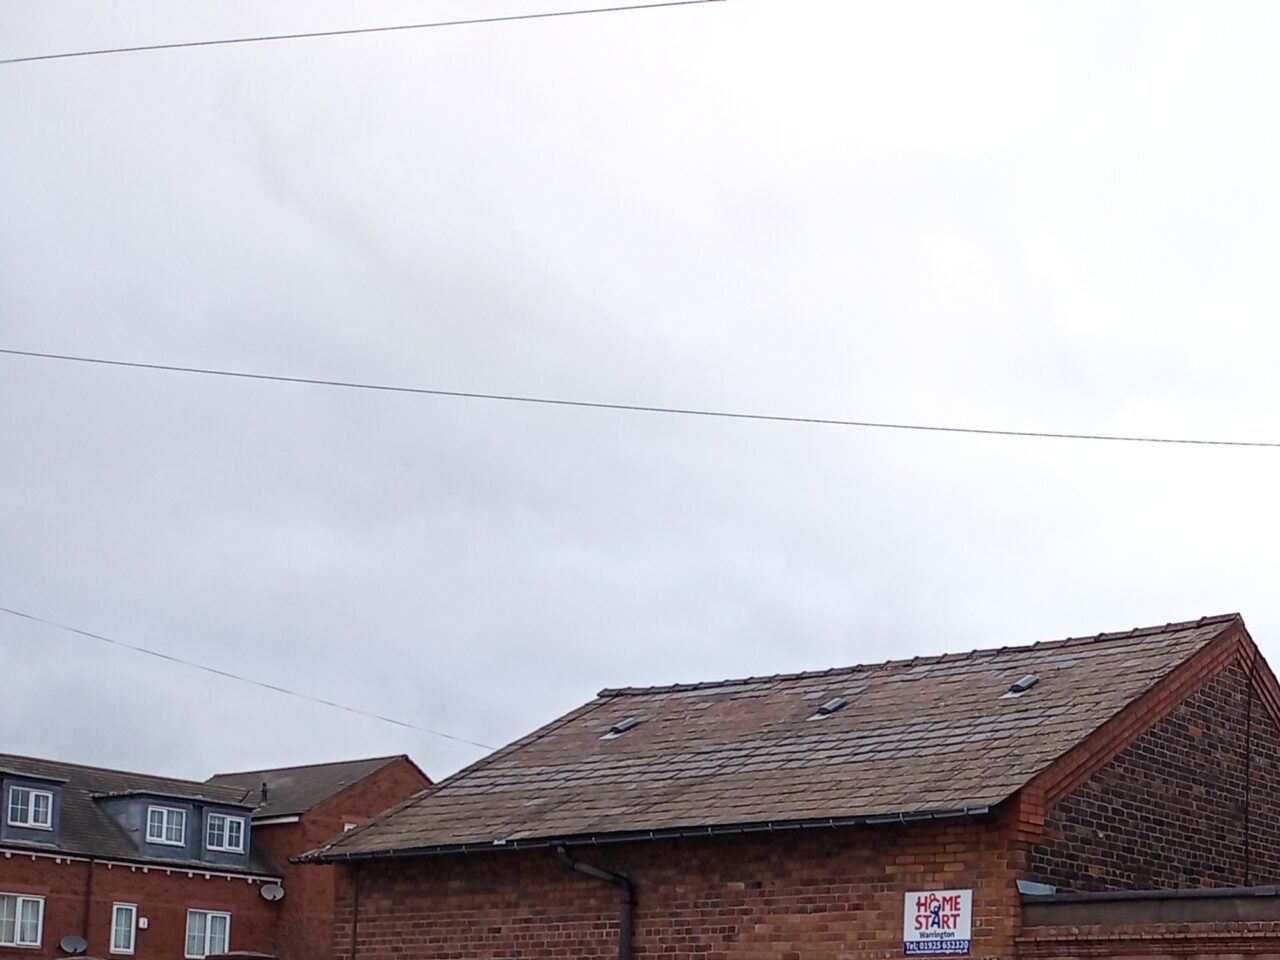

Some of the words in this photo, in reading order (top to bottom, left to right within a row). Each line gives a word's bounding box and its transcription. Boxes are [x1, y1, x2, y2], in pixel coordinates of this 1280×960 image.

[916, 893, 961, 913] HOME
[914, 913, 960, 930] START
[919, 931, 955, 939] Warrington
[920, 941, 941, 950] 01925
